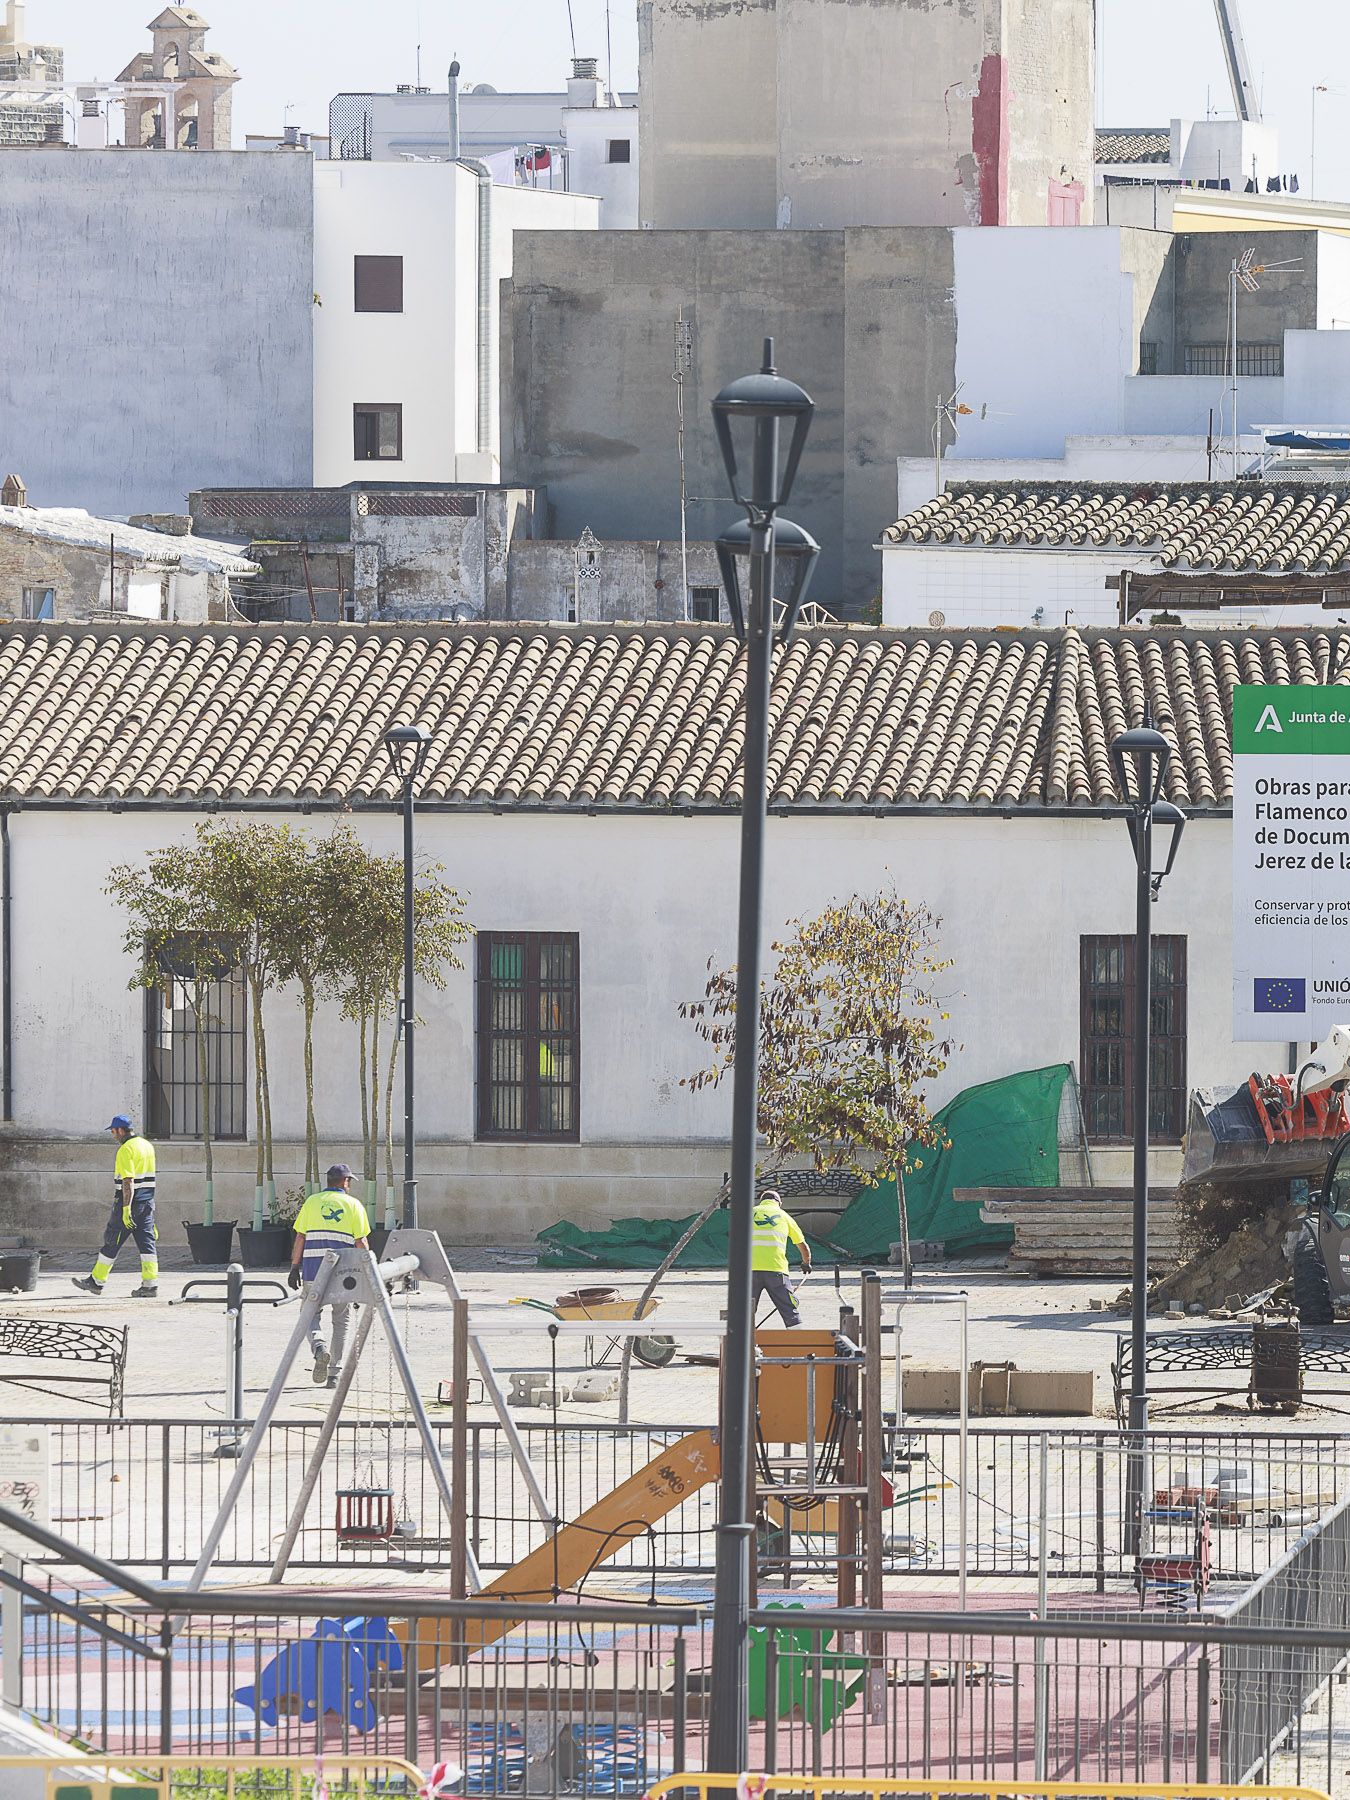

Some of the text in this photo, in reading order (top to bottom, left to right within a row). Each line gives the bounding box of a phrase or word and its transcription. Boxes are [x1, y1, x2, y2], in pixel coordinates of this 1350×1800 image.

[1288, 711, 1326, 724] Junta
[1329, 711, 1346, 723] de
[1255, 777, 1311, 796] Obras
[1255, 802, 1348, 821] Flamenco
[1255, 826, 1278, 845] de
[1255, 852, 1306, 870] Jerez
[1311, 851, 1335, 870] de
[1254, 899, 1315, 911] Conservar
[1317, 902, 1324, 914] y
[1254, 914, 1310, 925] eficiencia
[1314, 914, 1329, 925] de
[1331, 914, 1349, 925] los
